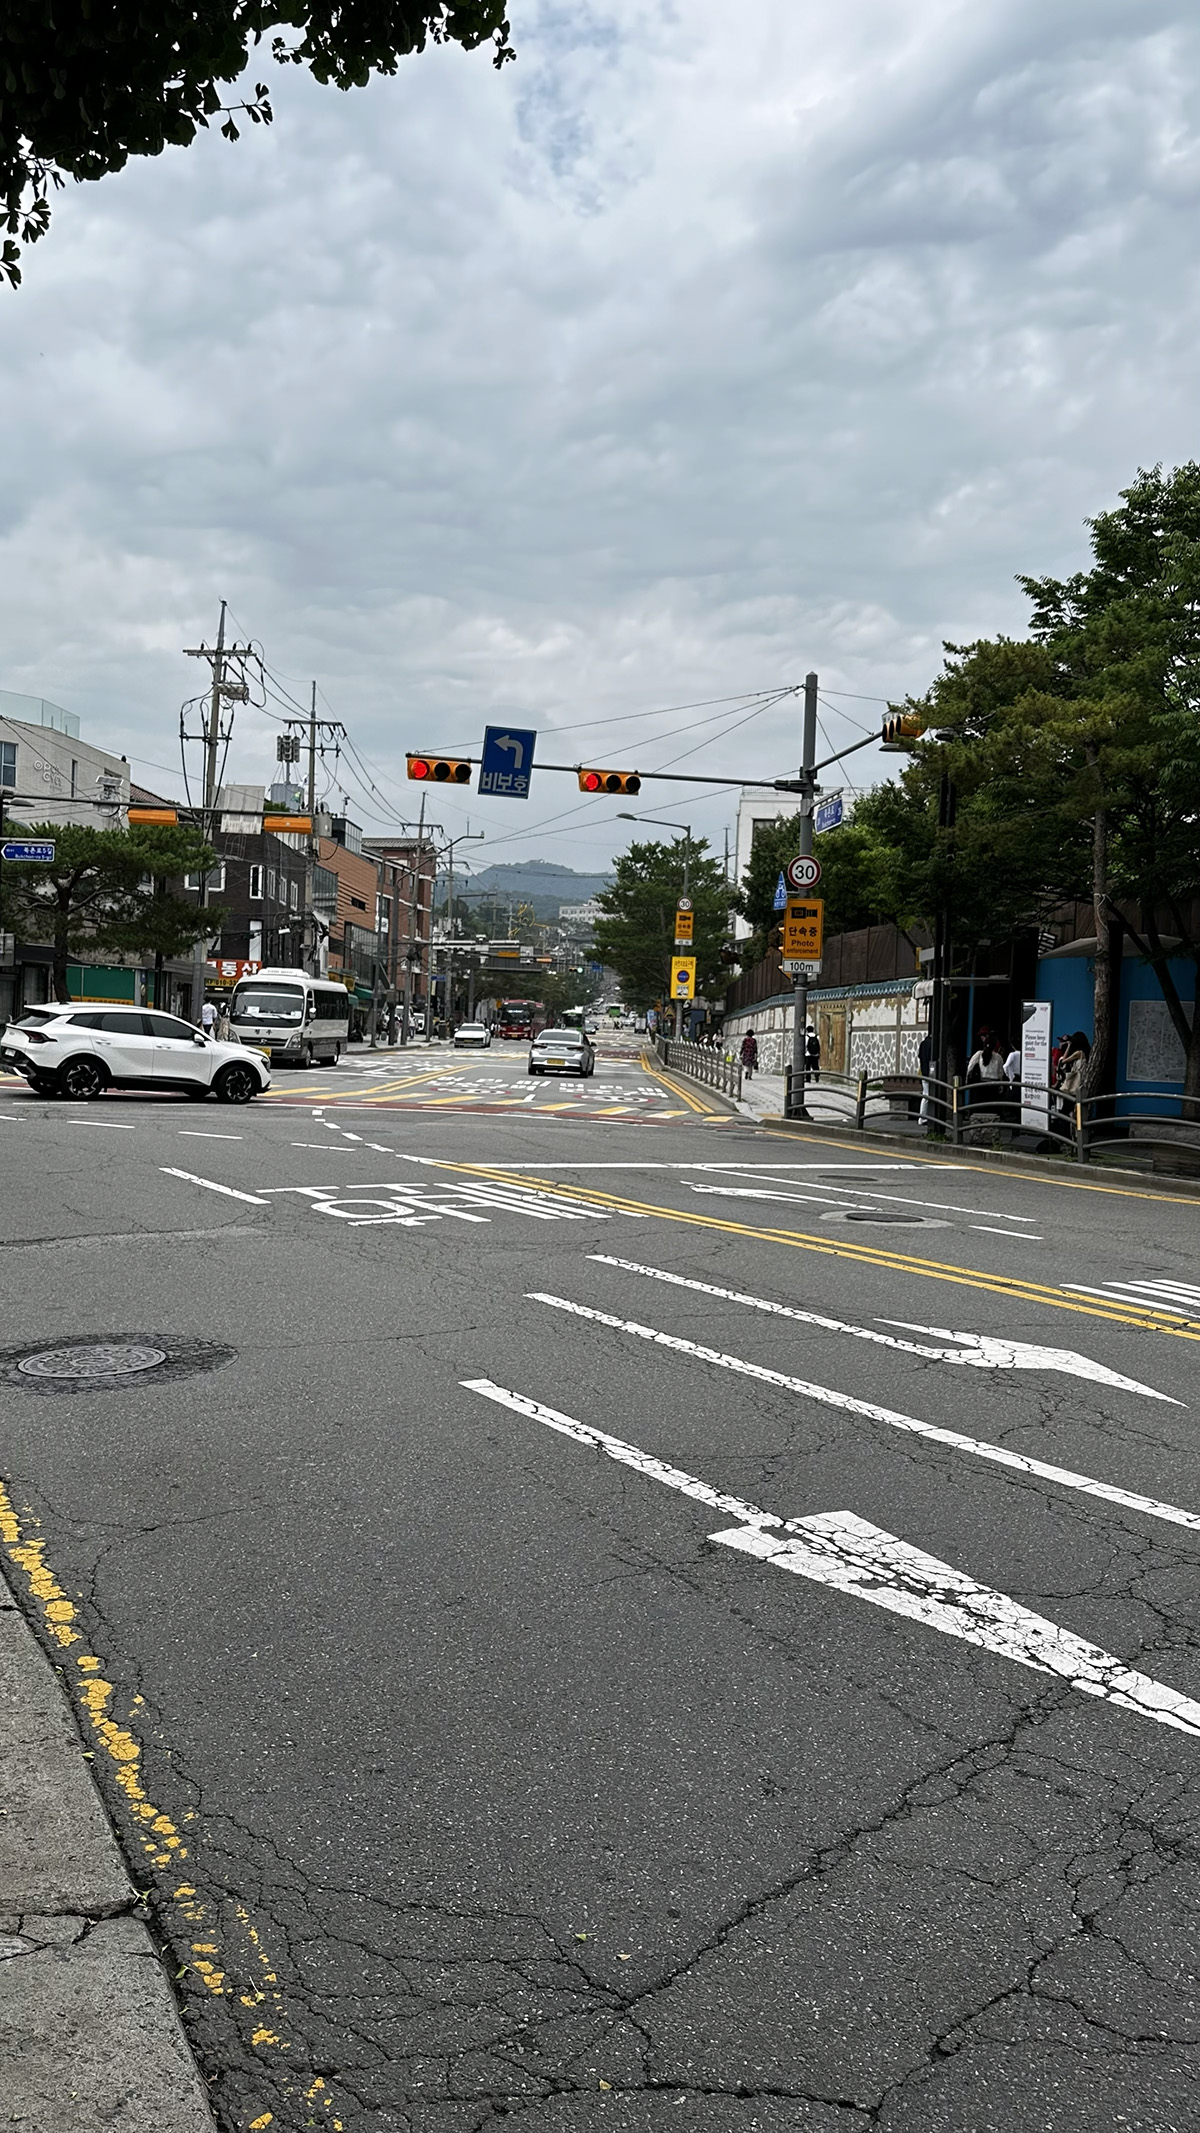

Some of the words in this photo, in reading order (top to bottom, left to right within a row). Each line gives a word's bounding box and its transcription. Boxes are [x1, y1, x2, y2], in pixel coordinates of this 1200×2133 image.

[482, 772, 528, 794] 비보호
[795, 865, 815, 880] 30
[788, 926, 818, 937] 단속중
[791, 939, 815, 947] Photo
[789, 961, 814, 972] 100m
